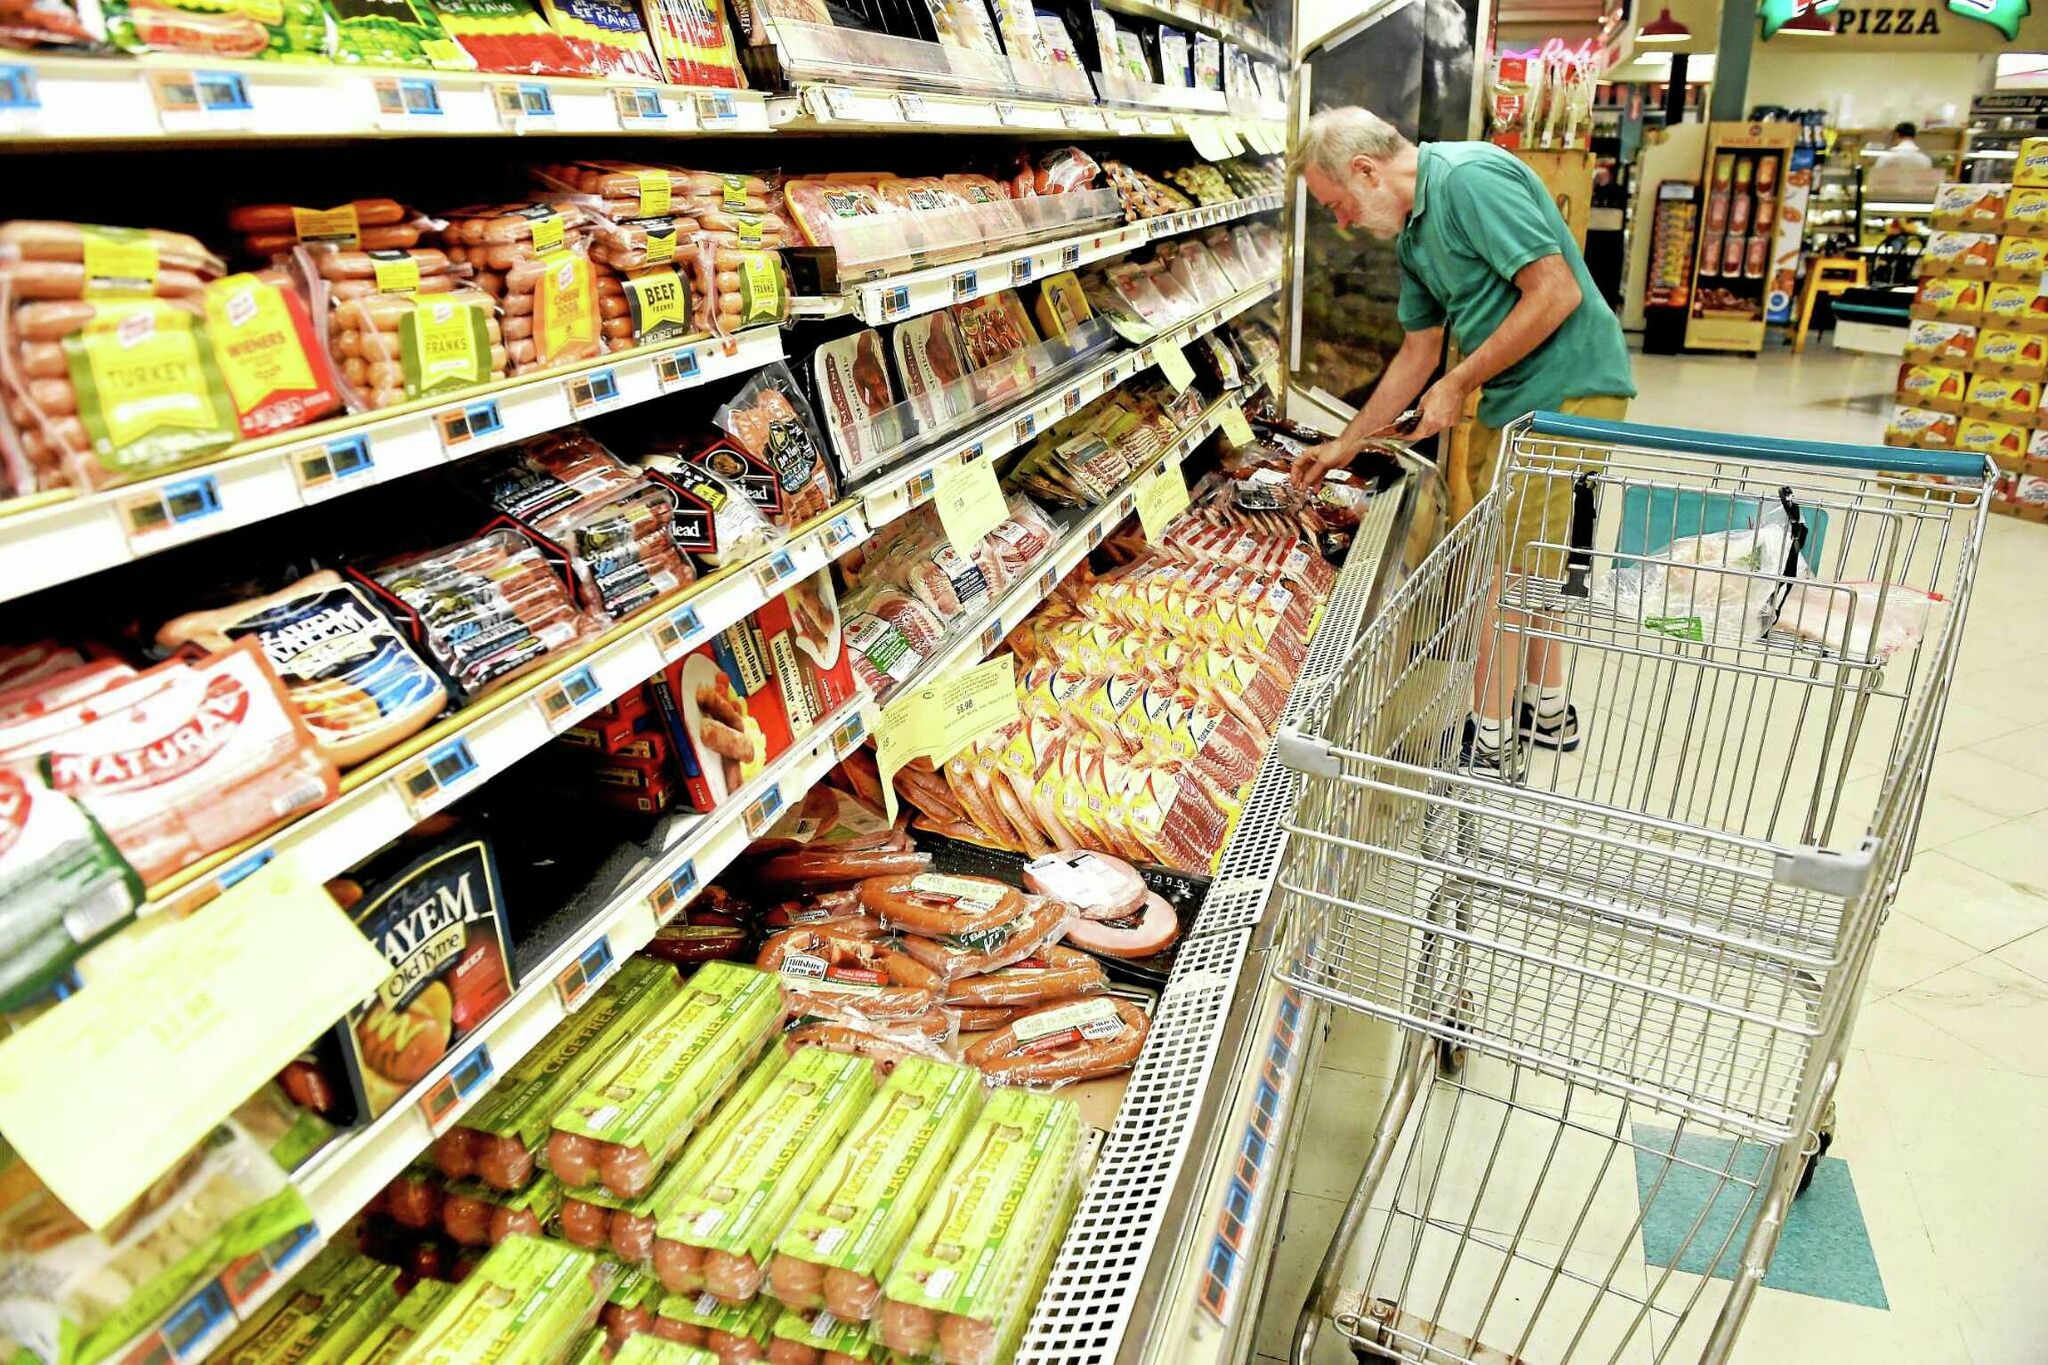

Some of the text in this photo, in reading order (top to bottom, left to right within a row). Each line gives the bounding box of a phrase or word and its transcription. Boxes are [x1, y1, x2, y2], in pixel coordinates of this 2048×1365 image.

[1837, 8, 1940, 34] PIZZA
[645, 283, 676, 306] BEEF
[107, 360, 188, 389] TURKEY
[425, 338, 468, 353] FRANKS
[54, 692, 240, 786] NATURAL
[370, 871, 481, 967] AYEM
[388, 957, 423, 998] Old
[786, 966, 807, 975] Farm
[788, 958, 821, 970] Hillshire
[540, 1034, 586, 1078] CAGE
[578, 1003, 619, 1042] FREE
[660, 1046, 698, 1087] CAGE
[691, 1012, 729, 1051] FREE
[760, 1135, 802, 1185] CAGE
[793, 1104, 825, 1143] FREE
[879, 1151, 918, 1204] CAGE
[909, 1118, 937, 1158] FREE
[986, 1188, 1022, 1243] CAGE
[1011, 1150, 1040, 1193] FREE
